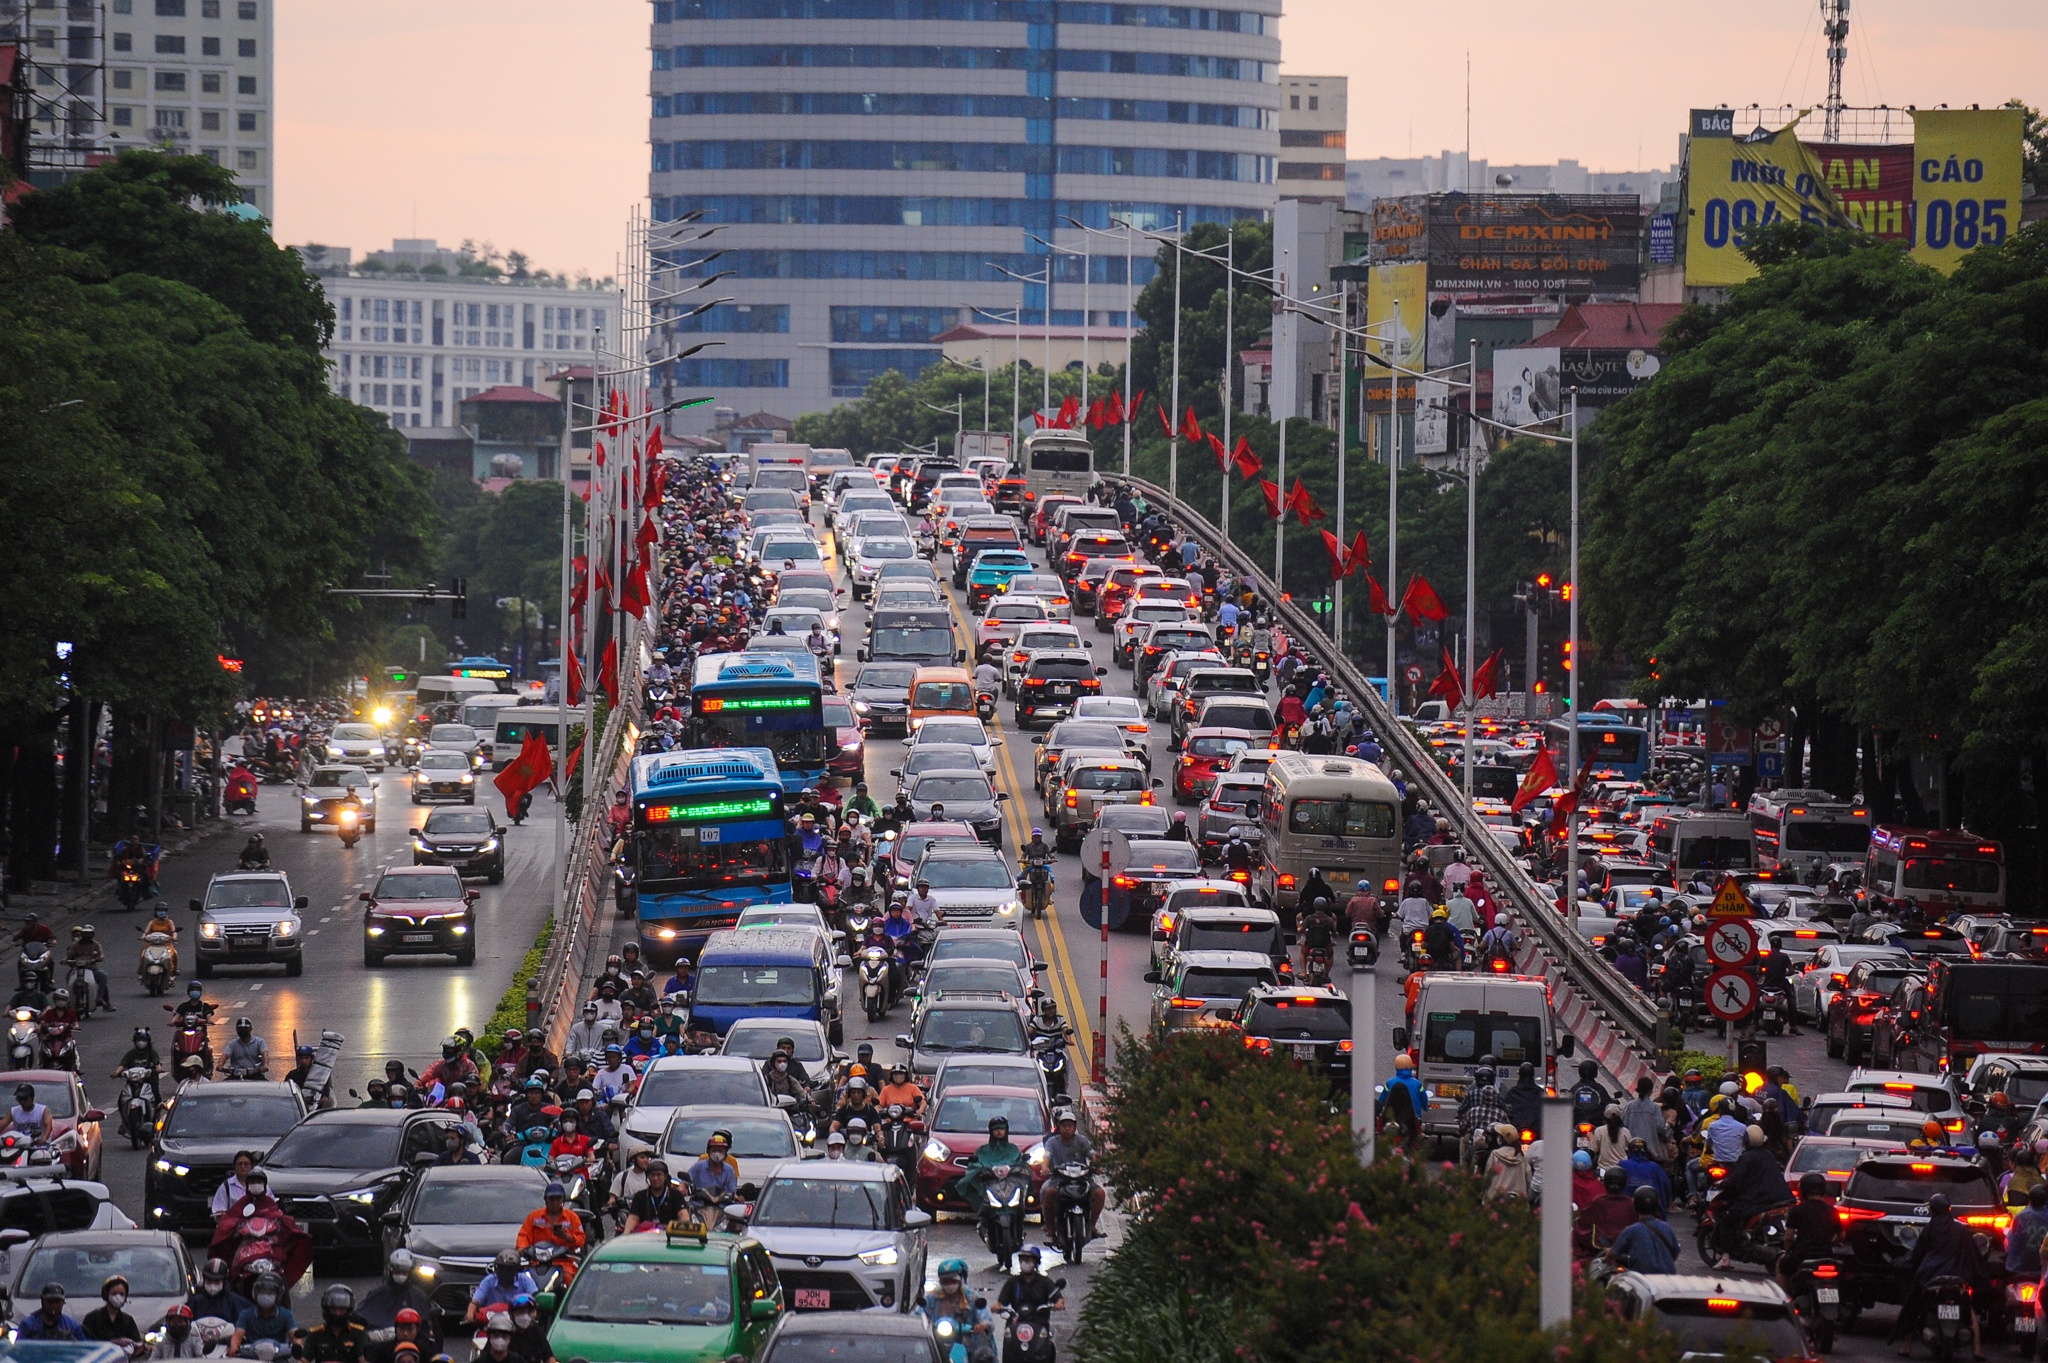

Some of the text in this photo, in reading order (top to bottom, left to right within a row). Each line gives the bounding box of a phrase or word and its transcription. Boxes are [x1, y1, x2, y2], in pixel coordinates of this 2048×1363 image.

[1920, 154, 1984, 183] CÁO
[1460, 224, 1608, 241] DEMXINH
[1505, 243, 1562, 253] LUXURY
[1510, 258, 1532, 270] GA
[1435, 279, 1502, 289] DEMXINH.VN
[1513, 279, 1540, 289] 1800
[702, 831, 719, 840] 107
[1725, 893, 1736, 901] ĐI
[1715, 902, 1745, 913] CHẬM
[805, 1290, 820, 1299] 30H
